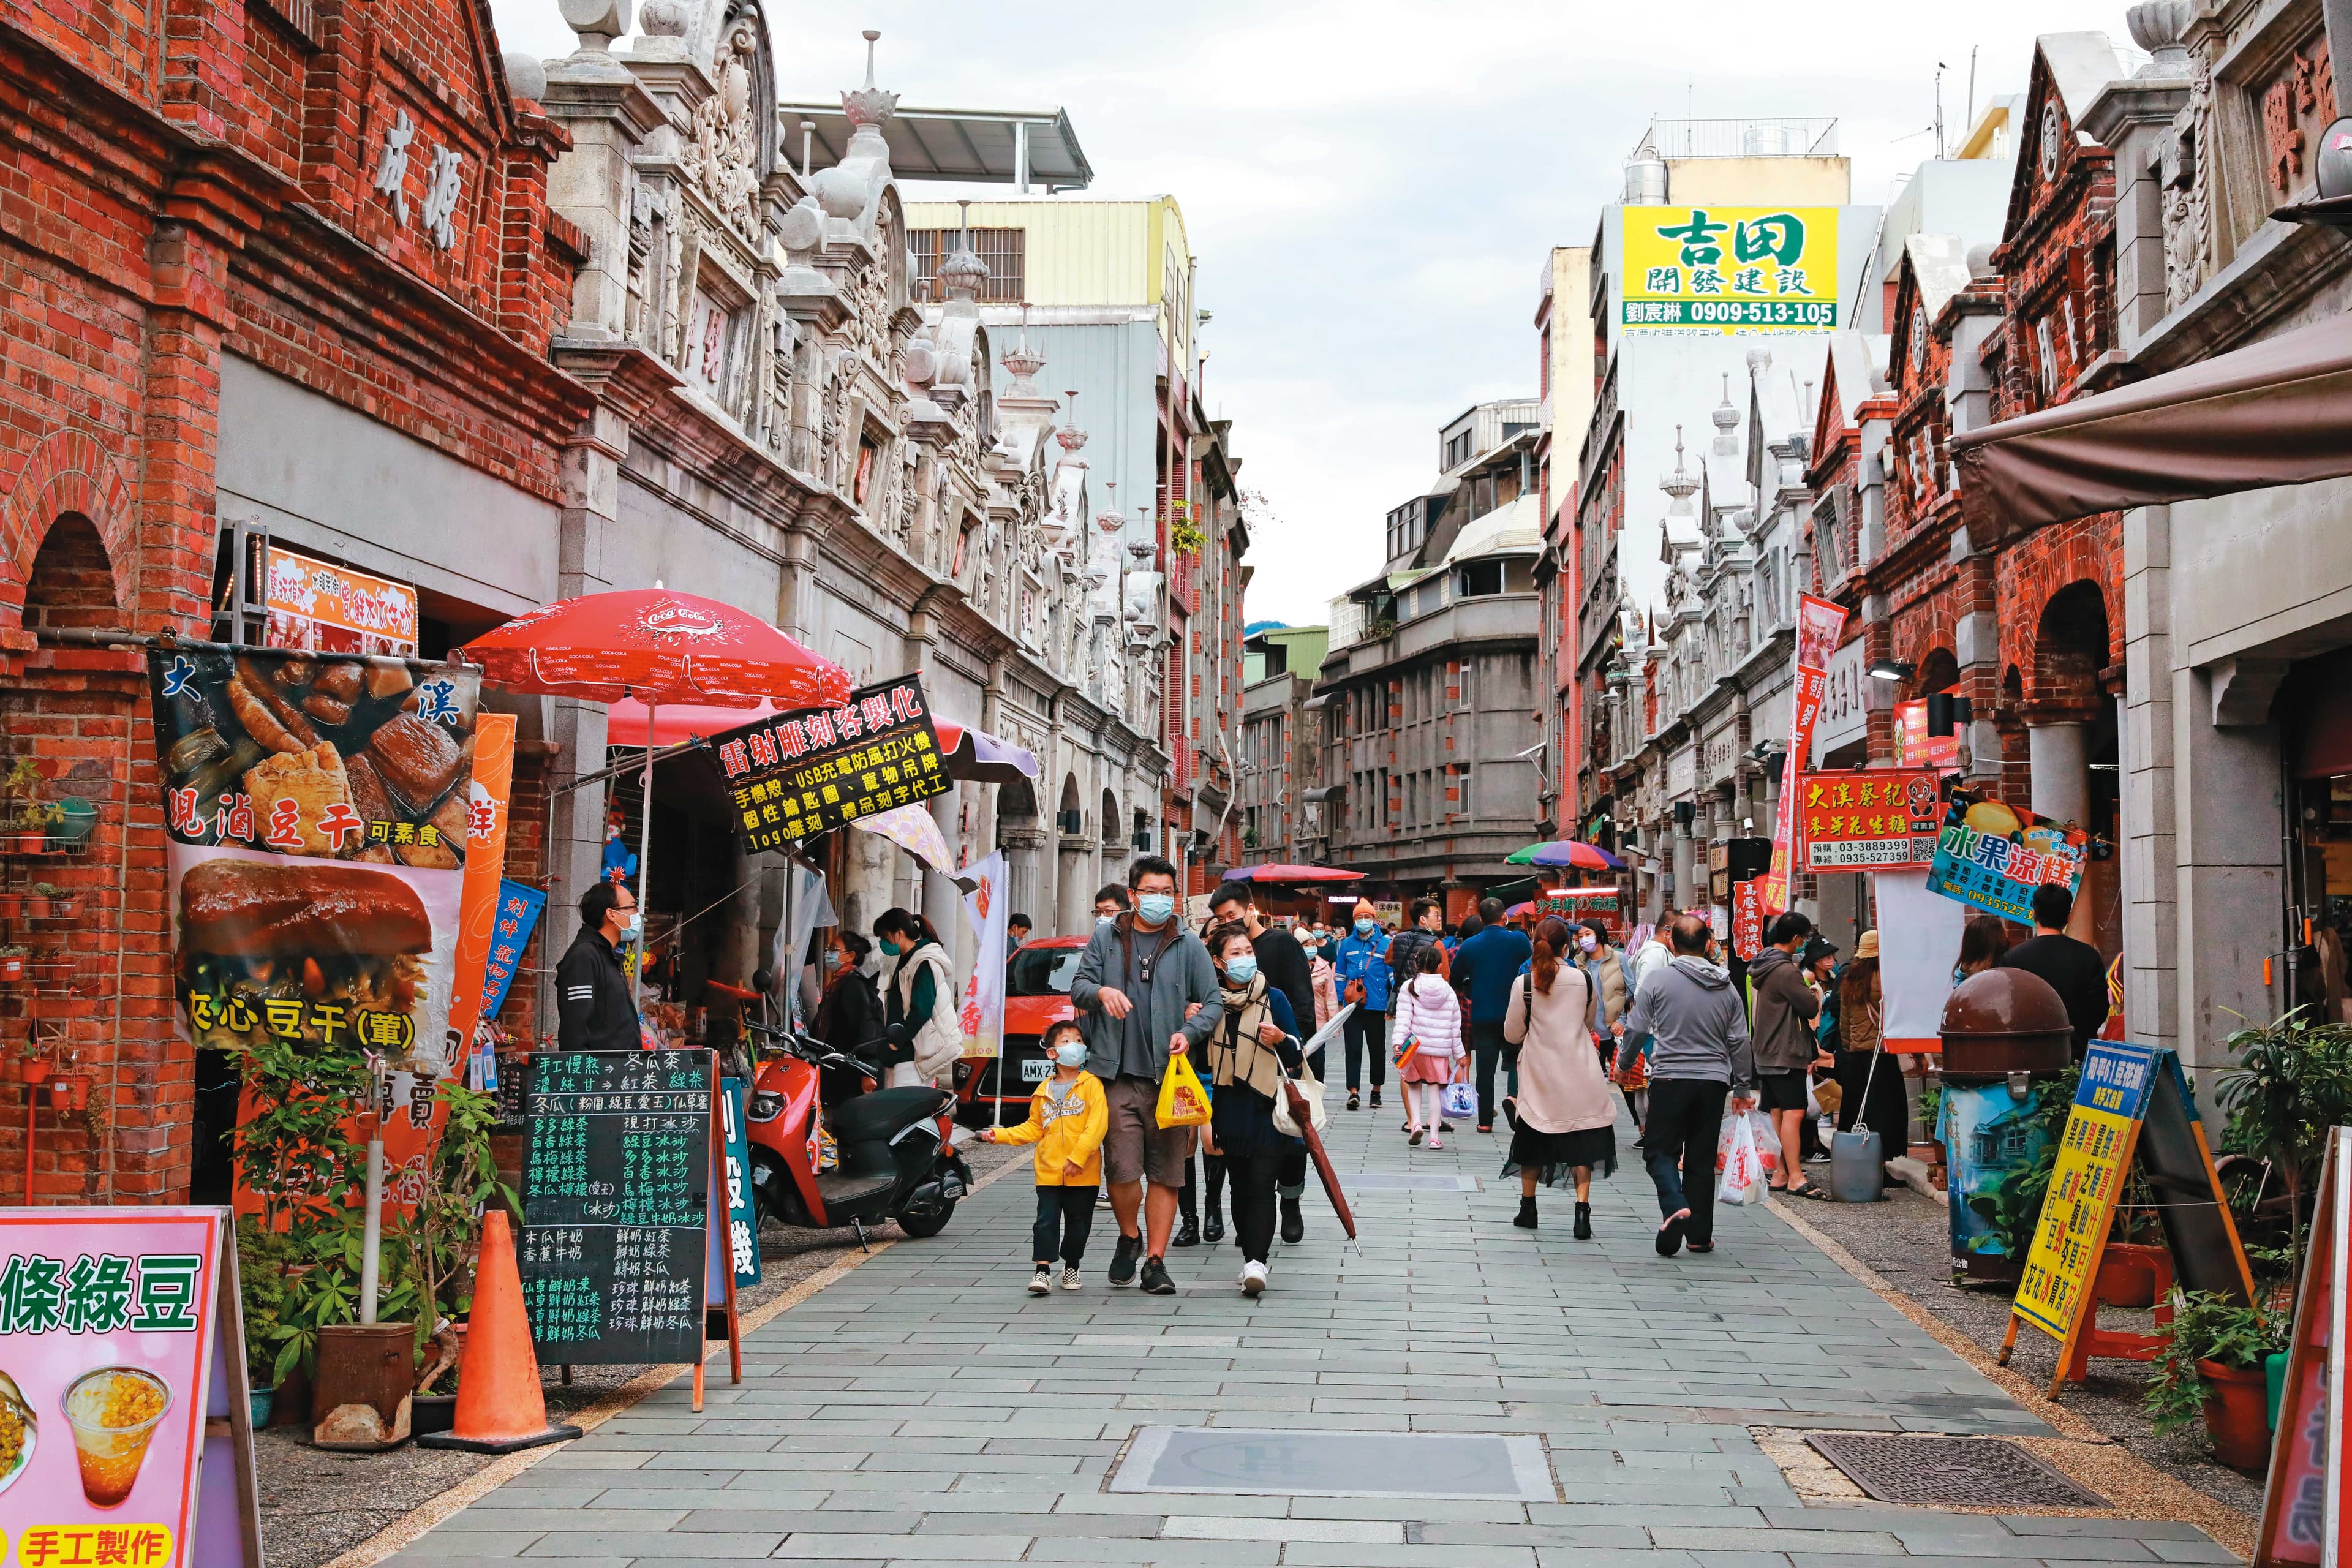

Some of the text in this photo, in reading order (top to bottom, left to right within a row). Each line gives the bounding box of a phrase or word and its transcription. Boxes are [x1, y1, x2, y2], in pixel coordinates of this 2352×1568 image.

[1657, 210, 1805, 267] 吉田
[1646, 268, 1813, 295] 開發建設
[1691, 303, 1833, 323] 0909-513-105
[341, 580, 412, 636] 曾鮮木瓜牛奶
[648, 608, 706, 624] Coca Cola
[162, 656, 460, 725] 大 溪
[719, 685, 923, 778] 雷射雕刻客製化
[735, 731, 932, 809] 手機殼、USB充電防風打火機
[742, 753, 938, 830] 個性鑰匙圈、寵物吊牌
[1807, 782, 1906, 809] 大溪蔡記
[168, 788, 363, 851] 現滷豆干
[749, 774, 946, 850] logo雕刻、禮品刻字代工
[371, 820, 440, 848] 可素食
[1808, 815, 1907, 838] 麥芽花生糖
[1912, 822, 1936, 831] 可素食
[1813, 840, 1908, 853] 預購 03-3889399
[1813, 852, 1908, 864] 專線 0935-527359
[1945, 825, 2075, 889] 水果涼糕
[1943, 881, 2034, 922] 電話: 09355273
[538, 1051, 680, 1075] 手工慢熬 冬瓜茶
[534, 1117, 588, 1134] 多多綠茶
[624, 1116, 700, 1130] 現打冰沙
[532, 1134, 587, 1148] 百香綠茶
[623, 1134, 688, 1151] 綠豆冰沙
[530, 1150, 588, 1166] 烏梅綠茶
[624, 1152, 688, 1167] 多多冰沙
[528, 1166, 588, 1183] 檸檬綠茶
[624, 1165, 689, 1180] 百香冰沙
[622, 1180, 689, 1197] 烏梅冰沙
[584, 1201, 620, 1219] (冰沙)
[621, 1197, 689, 1212] 檸檬冰沙
[2023, 1117, 2081, 1295] 黑豆花
[2032, 1120, 2090, 1300] 傳統豆花
[619, 1212, 705, 1226] 綠豆牛奶冰沙
[526, 1229, 583, 1245] 木瓜牛奶
[616, 1227, 673, 1244] 鮮奶紅茶
[524, 1246, 582, 1262] 香蕉牛奶
[614, 1243, 671, 1261] 鮮奶綠茶
[612, 1261, 670, 1277] 鮮奶冬瓜
[0, 1255, 202, 1333] 條綠豆
[612, 1278, 692, 1295] 珍珠鮮奶紅茶
[610, 1295, 692, 1315] 珍珠鮮奶綠茶
[609, 1316, 692, 1332] 珍珠鮮奶冬瓜
[26, 1529, 166, 1567] 手工製作
